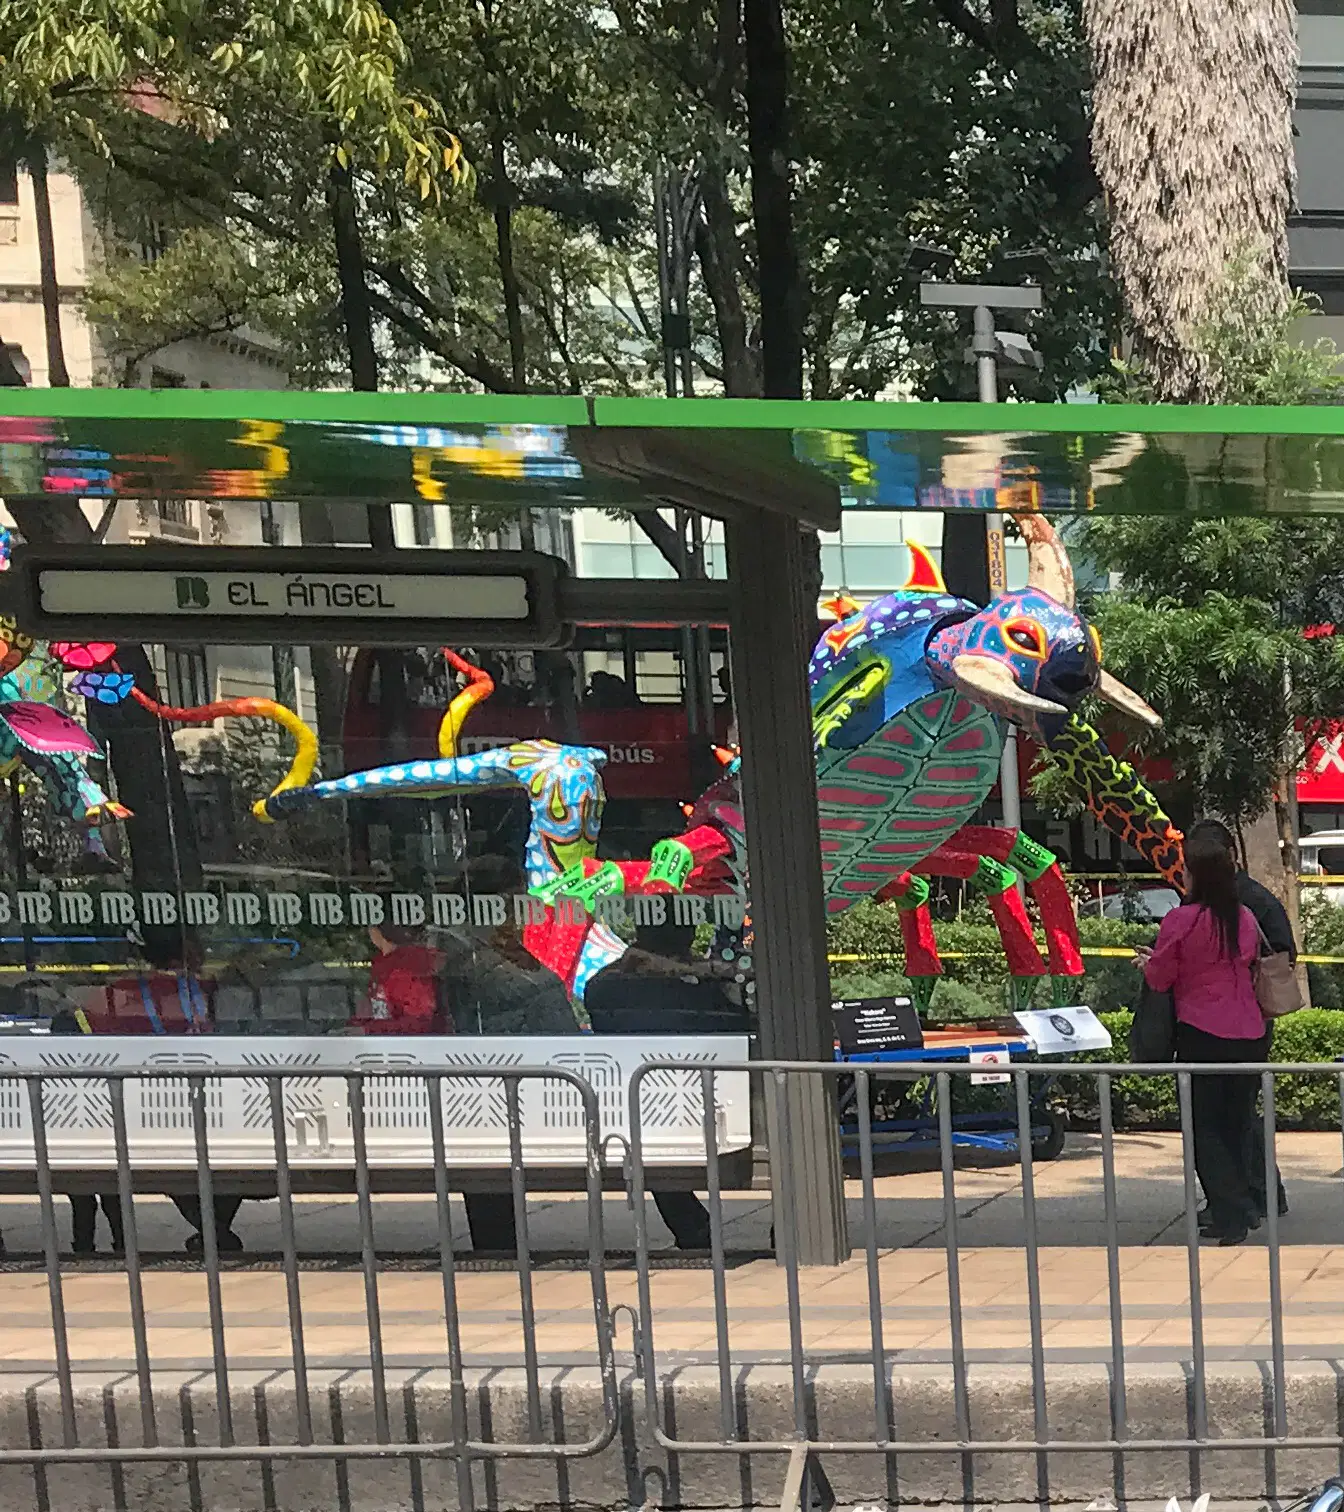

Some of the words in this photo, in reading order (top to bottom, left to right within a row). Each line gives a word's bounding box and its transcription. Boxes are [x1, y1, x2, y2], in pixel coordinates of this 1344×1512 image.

[227, 581, 268, 606] EL
[286, 575, 395, 608] ÁNGEL
[609, 742, 655, 764] bús
